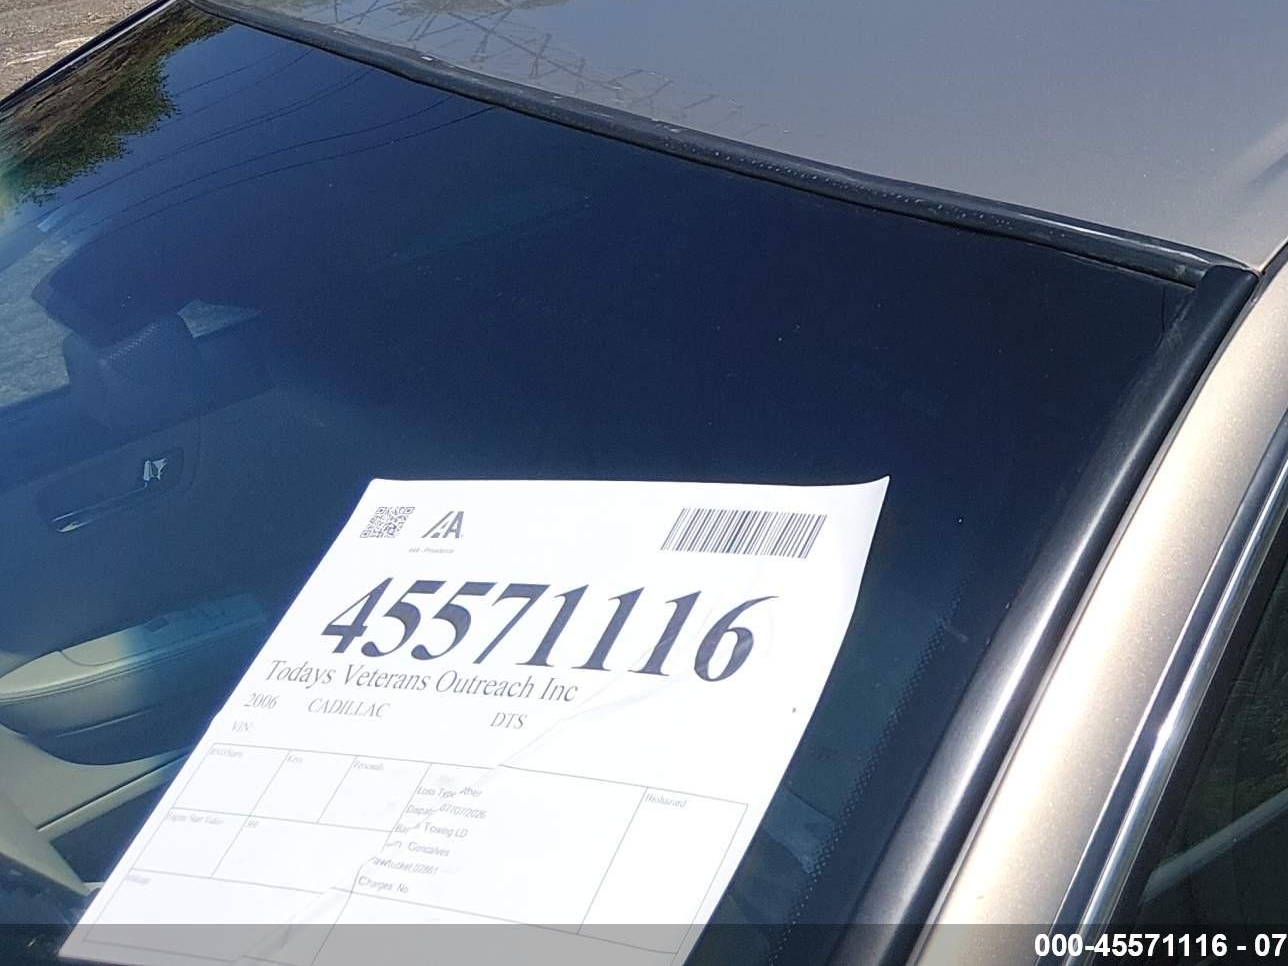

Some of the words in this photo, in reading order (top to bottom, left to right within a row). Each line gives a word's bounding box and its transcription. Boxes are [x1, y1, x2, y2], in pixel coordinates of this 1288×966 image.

[321, 577, 780, 682] 45571116
[264, 659, 336, 689] Todays
[343, 664, 432, 692] Veterans
[435, 669, 535, 699] Outreach
[538, 677, 580, 703] Inc
[243, 692, 278, 709] 2006
[307, 697, 391, 718] CADILLAC
[490, 712, 528, 730] DTS
